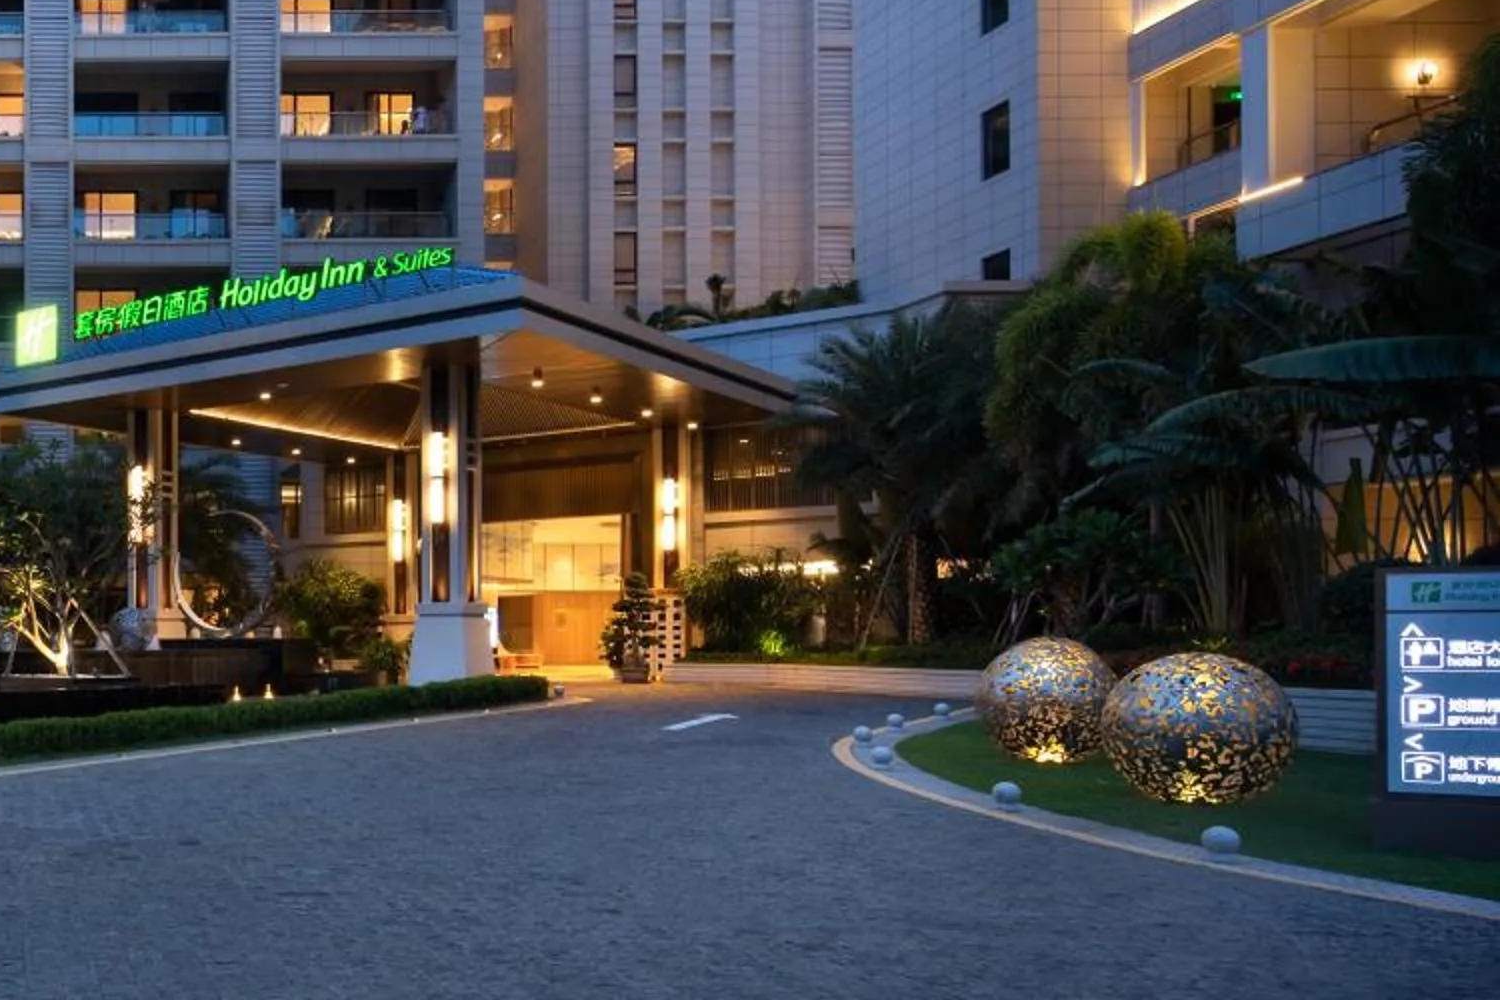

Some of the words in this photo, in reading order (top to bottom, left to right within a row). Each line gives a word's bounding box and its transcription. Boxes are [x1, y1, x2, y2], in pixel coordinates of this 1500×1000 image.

[219, 267, 317, 309] Holiday
[320, 257, 366, 290] Inn
[373, 256, 388, 278] &
[392, 248, 452, 275] Suites
[1447, 655, 1482, 667] hotel
[1448, 714, 1496, 726] ground
